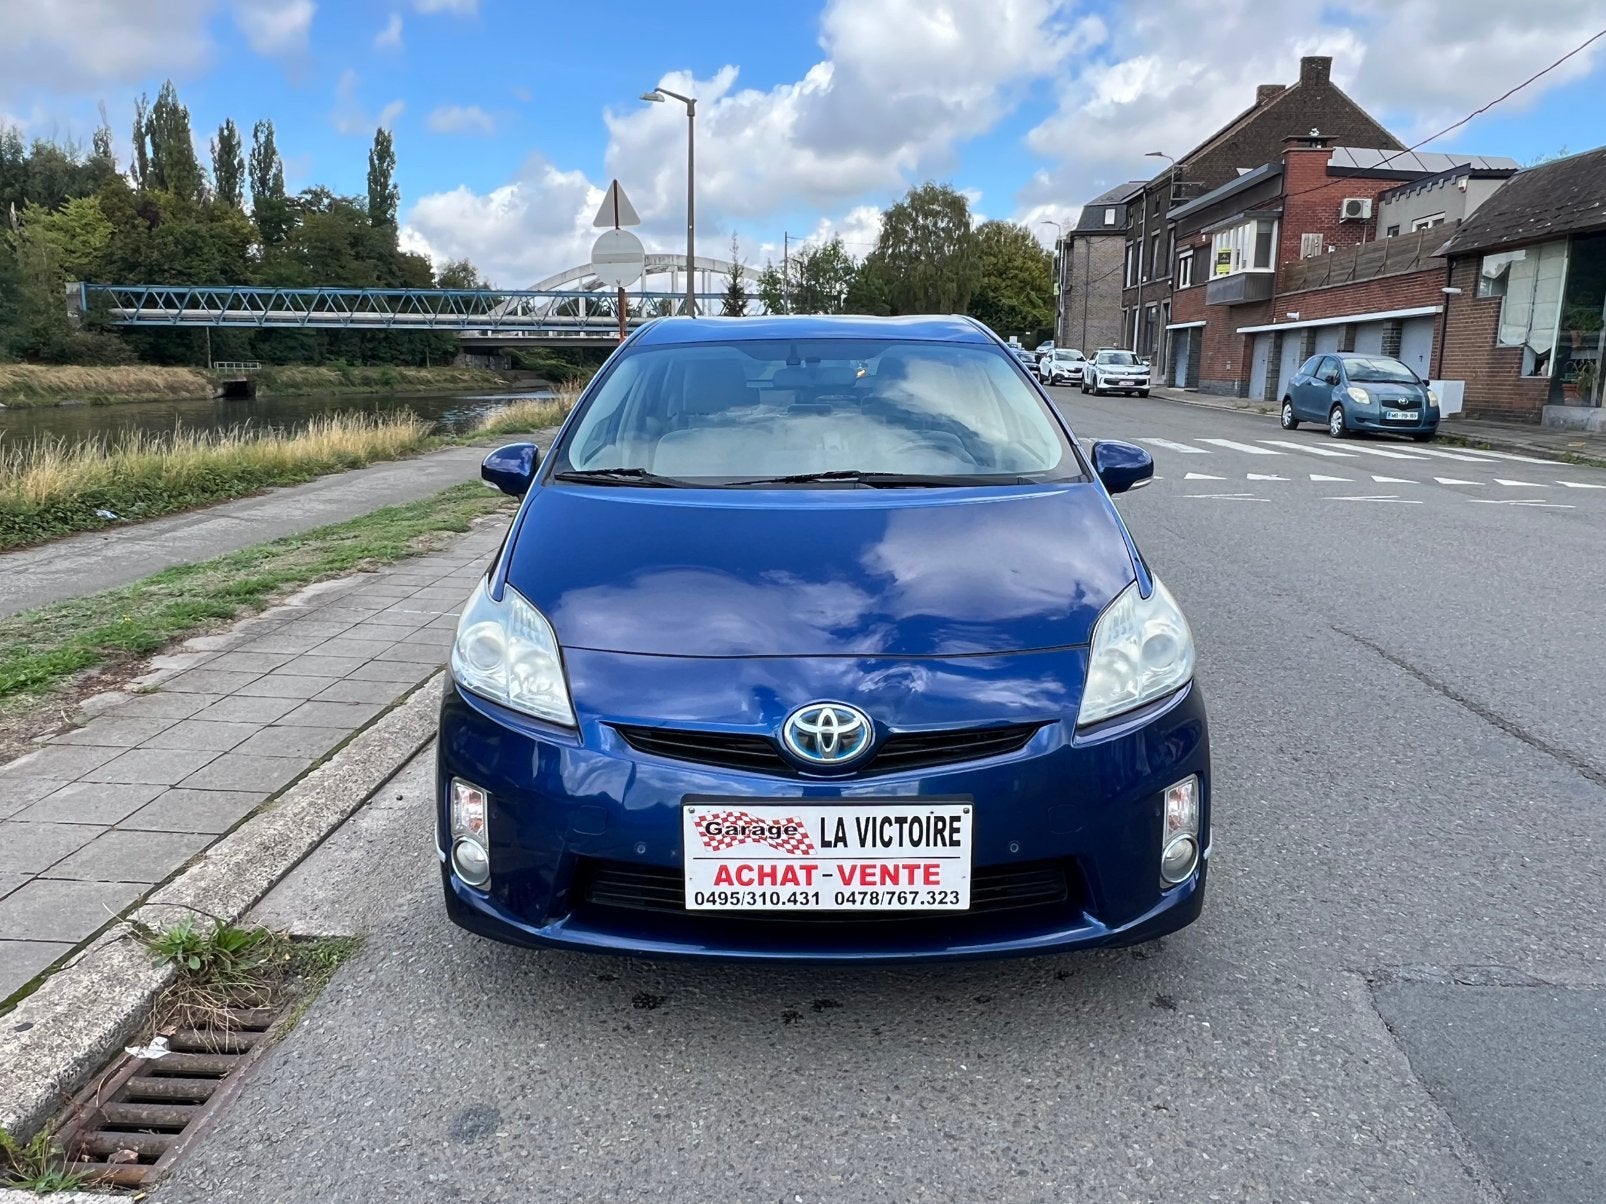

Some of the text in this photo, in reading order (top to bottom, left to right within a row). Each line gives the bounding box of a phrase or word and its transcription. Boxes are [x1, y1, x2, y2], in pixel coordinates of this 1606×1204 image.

[705, 815, 961, 848] Garage LA VICTOIRE
[694, 890, 960, 906] 0495/310.431 0478/767.323
